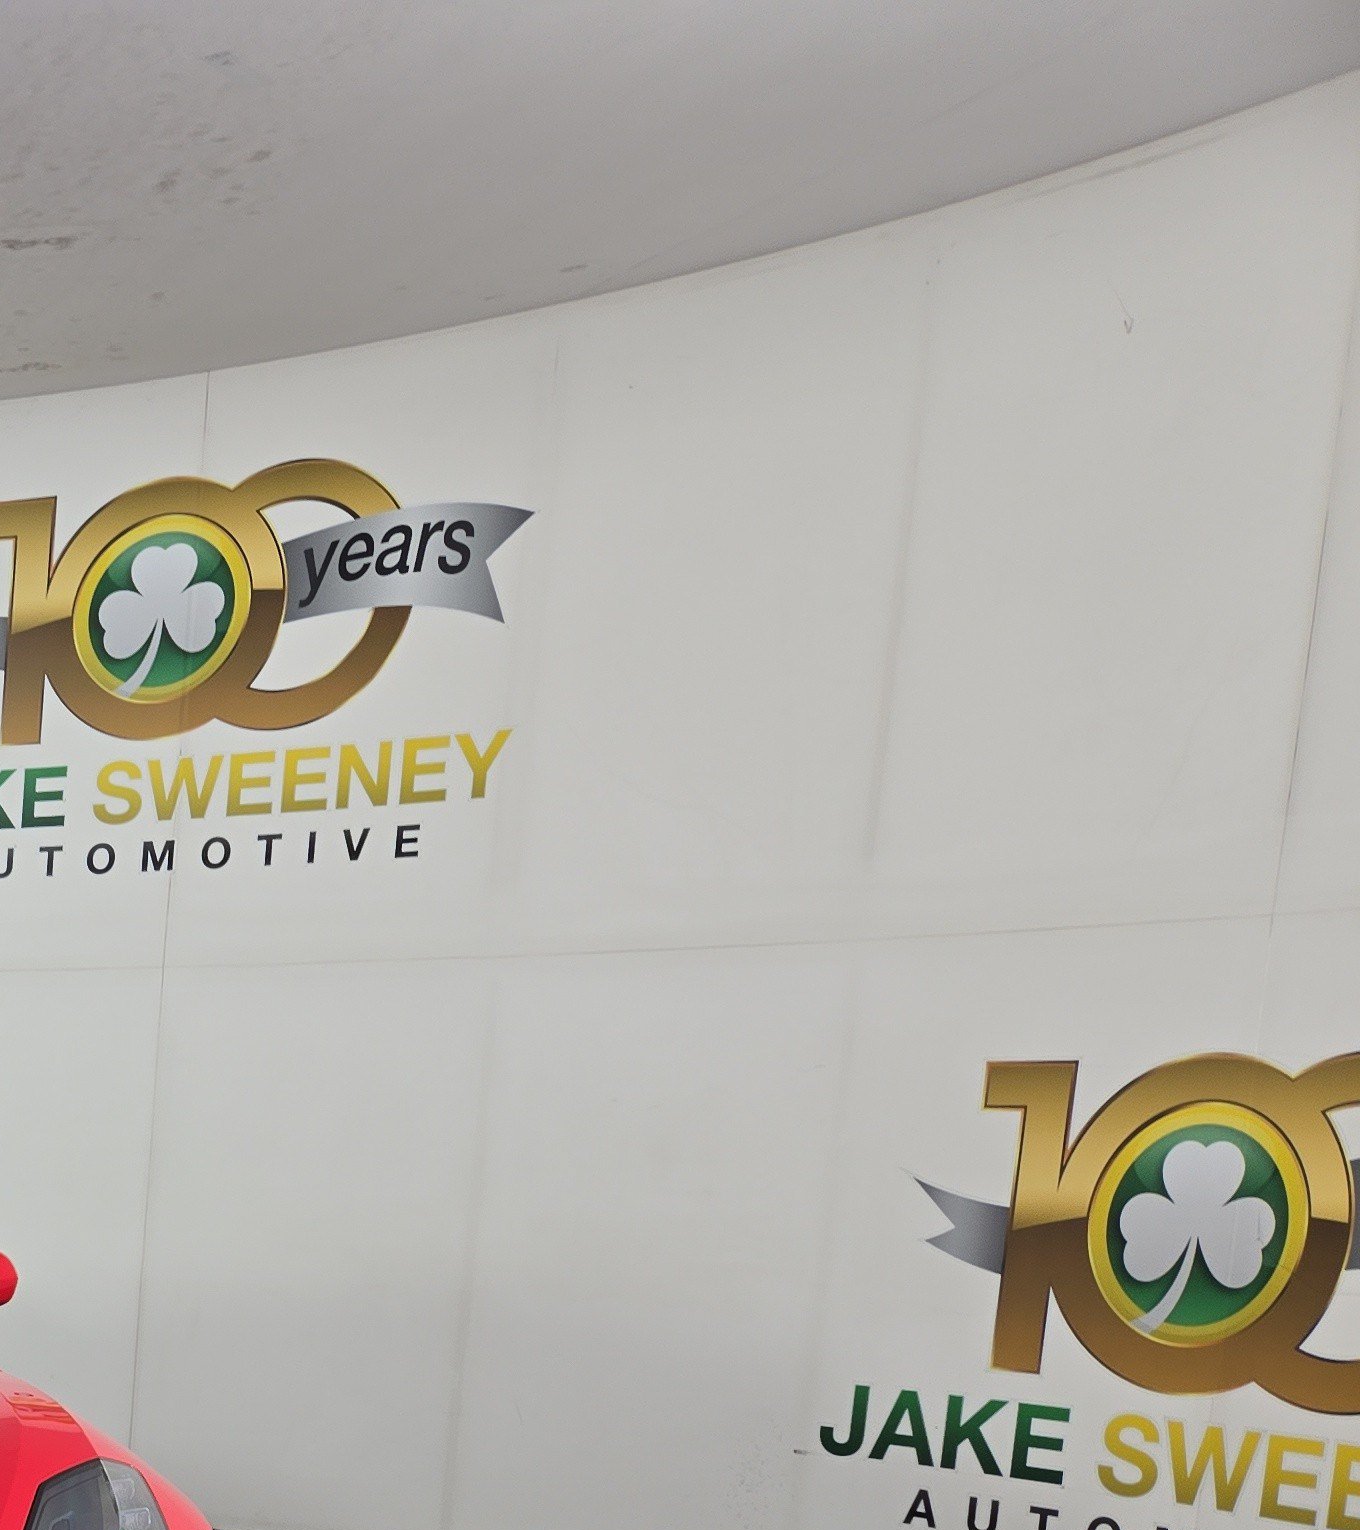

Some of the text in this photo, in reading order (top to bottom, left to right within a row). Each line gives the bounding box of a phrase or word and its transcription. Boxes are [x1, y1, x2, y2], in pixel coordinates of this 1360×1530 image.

[299, 517, 476, 608] years
[91, 727, 514, 827] SWEENEY
[818, 1383, 1072, 1486] JAKE
